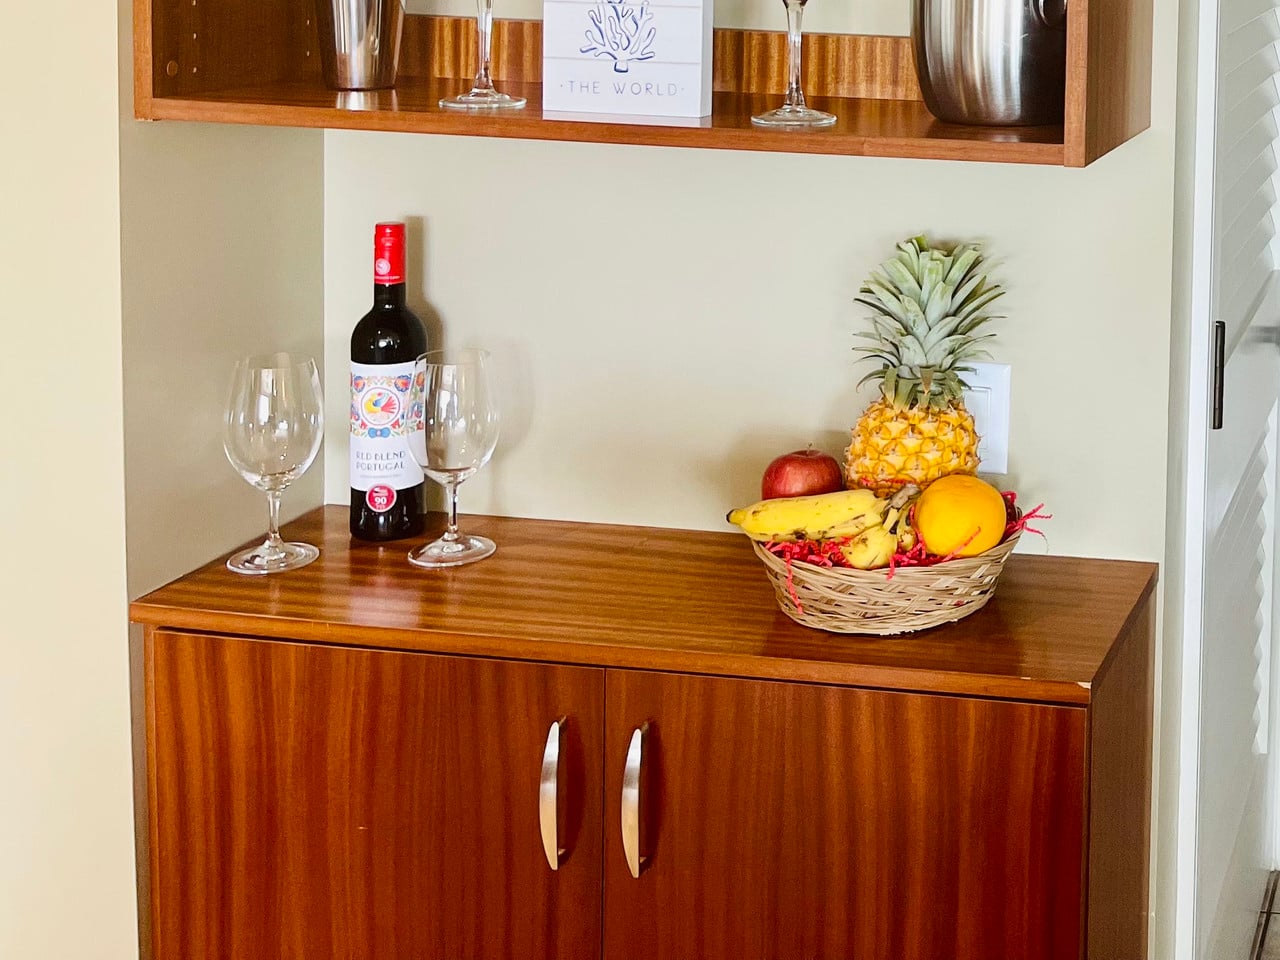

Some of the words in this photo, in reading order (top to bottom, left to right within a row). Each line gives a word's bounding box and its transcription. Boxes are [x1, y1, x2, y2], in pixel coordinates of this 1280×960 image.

[568, 80, 601, 95] THE
[612, 82, 678, 97] WORLD
[356, 461, 405, 471] PORTUGAL
[374, 496, 388, 505] 90
